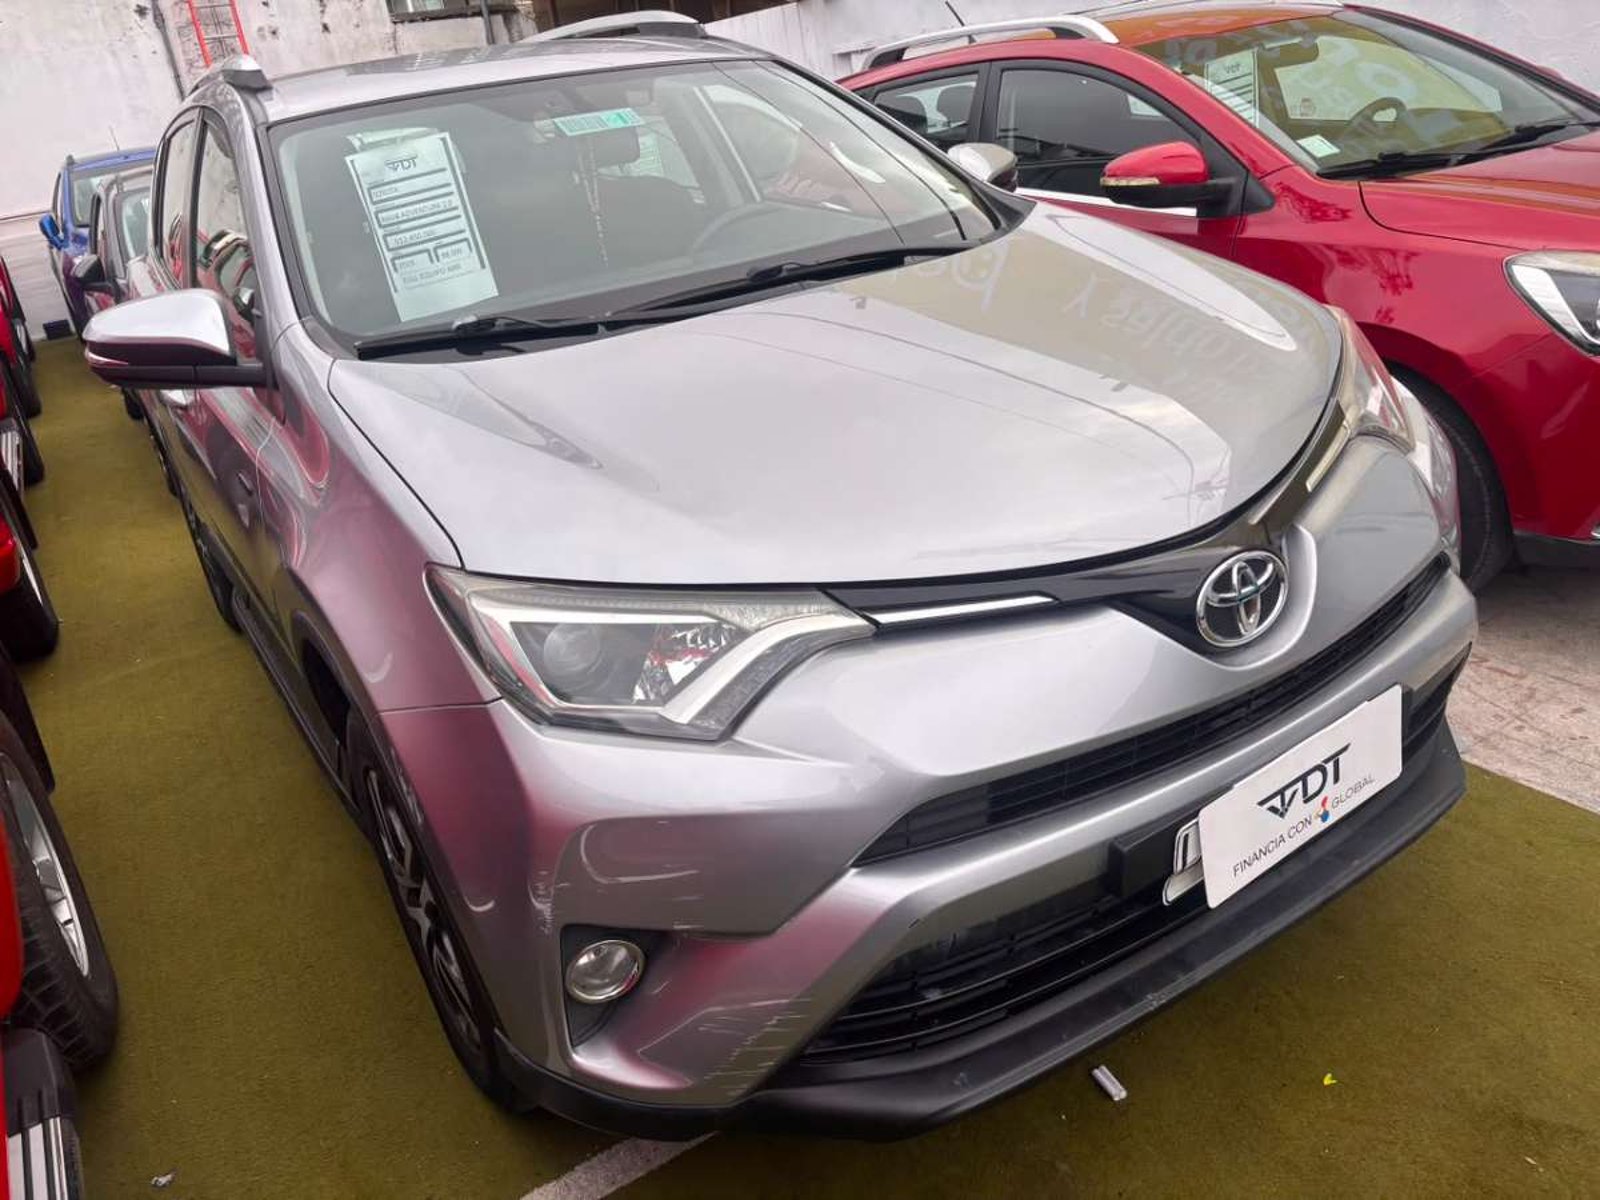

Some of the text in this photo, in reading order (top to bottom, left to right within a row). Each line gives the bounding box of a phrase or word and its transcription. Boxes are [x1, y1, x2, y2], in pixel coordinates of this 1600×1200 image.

[1232, 832, 1287, 878] FINANCIA
[1287, 814, 1314, 840] CON
[1331, 773, 1377, 810] GLOBAL
[1257, 743, 1351, 820] VDT
